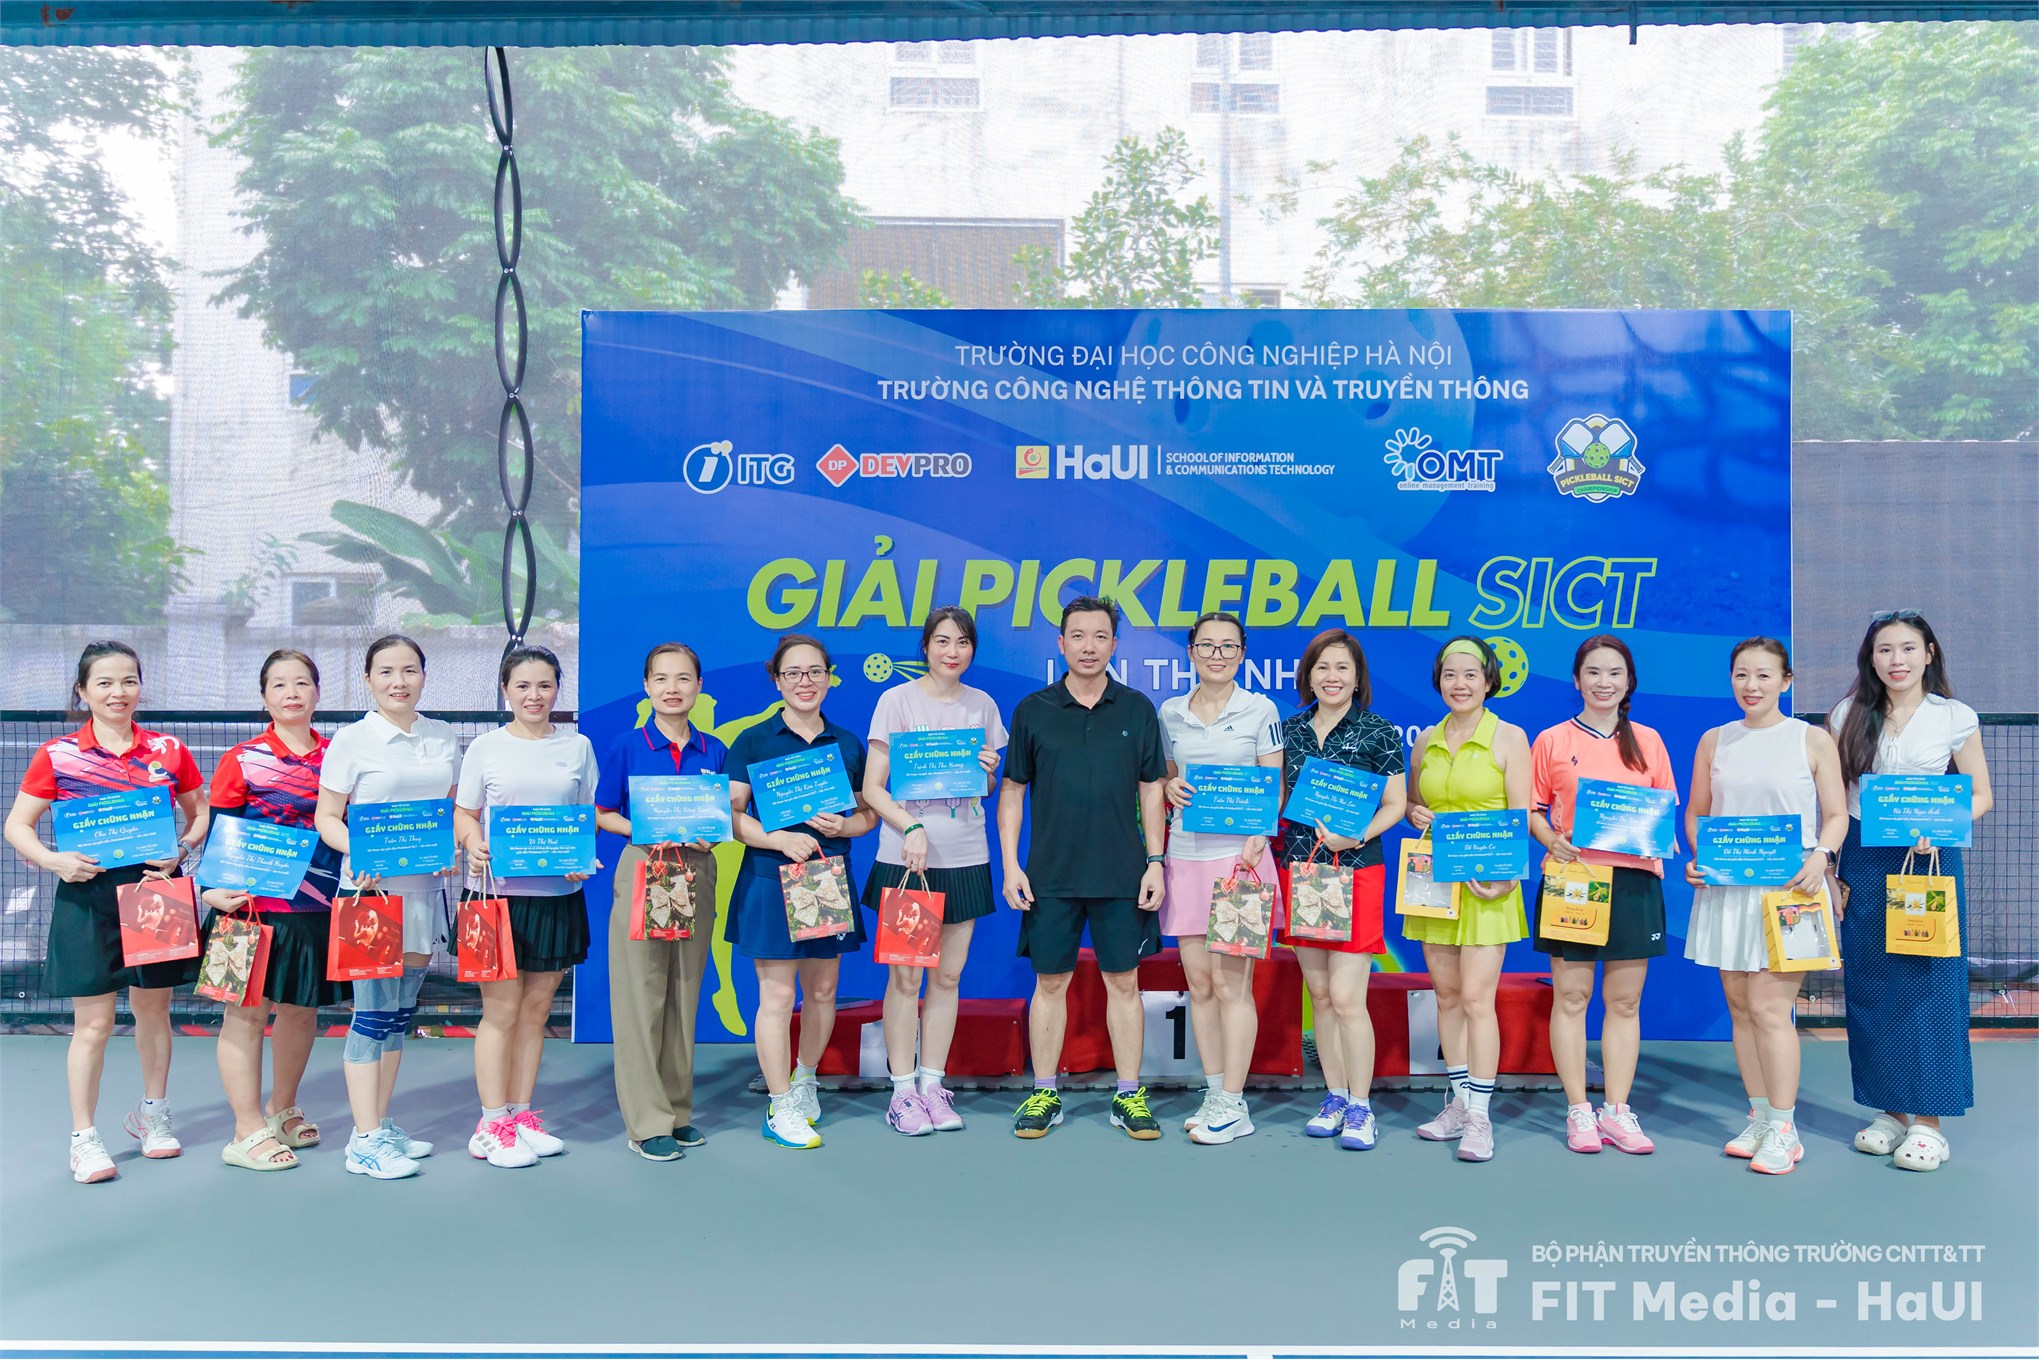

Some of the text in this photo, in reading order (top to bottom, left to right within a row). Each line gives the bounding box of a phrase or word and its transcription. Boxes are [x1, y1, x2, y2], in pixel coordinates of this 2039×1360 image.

[955, 340, 1452, 370] TRƯỜNG ĐẠI HỌC CÔNG NGHIỆP HÀ NỘI
[877, 372, 1529, 404] TRƯỜNG CÔNG NGHỆ THÔNG TIN VÀ TRUYỀN THÔNG
[738, 454, 795, 485] ITG
[828, 460, 848, 471] DP
[860, 452, 972, 478] DEVPRO
[1056, 444, 1148, 480] HaUI
[1166, 452, 1295, 463] SCHOOL OF INFORMATION
[1166, 464, 1335, 475] & COMMUNICATIONS TECHNOLOGY
[1416, 450, 1503, 482] OMT
[1399, 481, 1494, 491] online management training
[1560, 473, 1635, 488] PICKLEBALL SICT
[747, 535, 1657, 629] GIẢI PICKLEBALL SICT
[1165, 1005, 1186, 1060] 1
